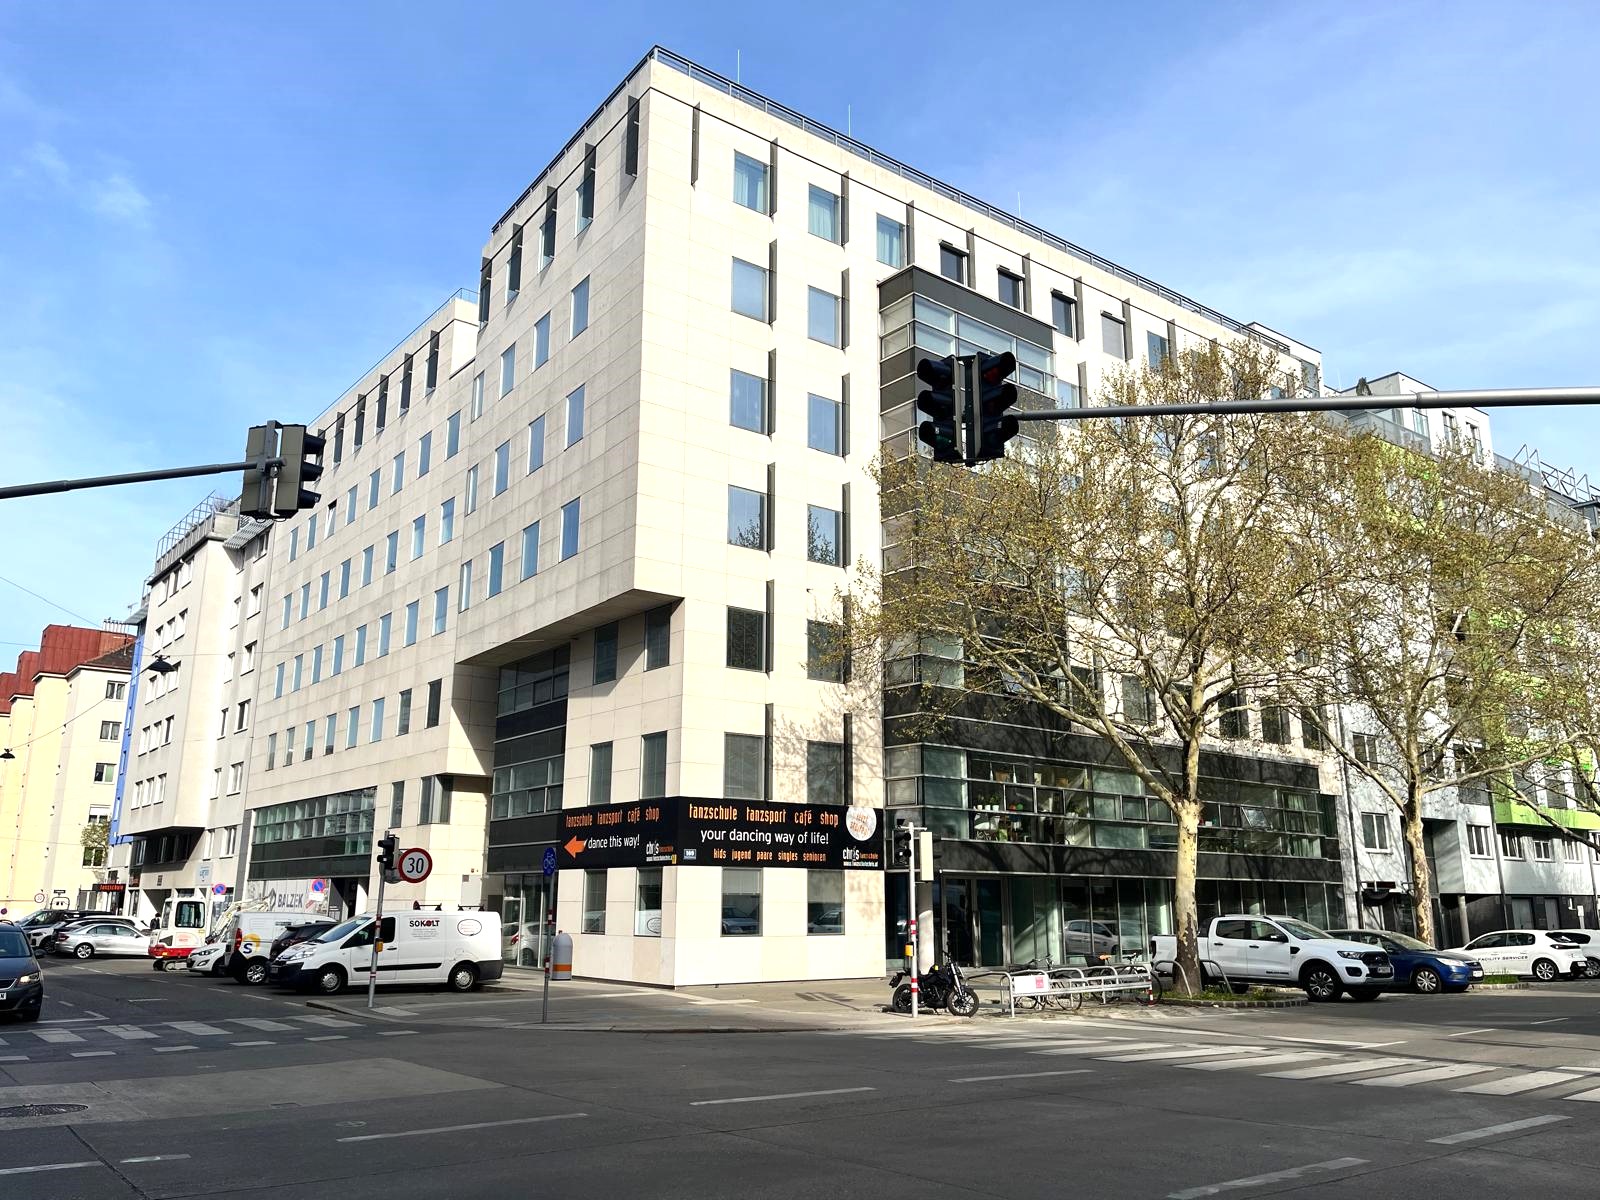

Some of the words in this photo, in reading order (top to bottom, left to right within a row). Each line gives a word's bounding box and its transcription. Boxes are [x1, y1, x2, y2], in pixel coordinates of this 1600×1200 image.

[566, 813, 593, 828] tanzschule
[597, 810, 622, 826] tanzsport
[627, 807, 640, 824] café
[645, 806, 660, 821] shop
[689, 803, 738, 820] tanzschule
[746, 806, 787, 824] tanzsport
[794, 809, 813, 826] café
[820, 810, 839, 828] shop
[588, 837, 608, 849] dance
[609, 835, 622, 847] this
[624, 834, 640, 849] way!
[700, 829, 727, 843] your
[729, 828, 772, 845] dancing
[774, 832, 795, 846] way
[797, 831, 808, 844] of
[810, 831, 829, 845] life!
[713, 848, 727, 859] kids
[731, 848, 752, 861] jugend
[756, 851, 773, 861] paare
[778, 850, 798, 862] singles
[803, 851, 827, 862] senioren
[406, 857, 425, 874] 30
[242, 942, 253, 954] S
